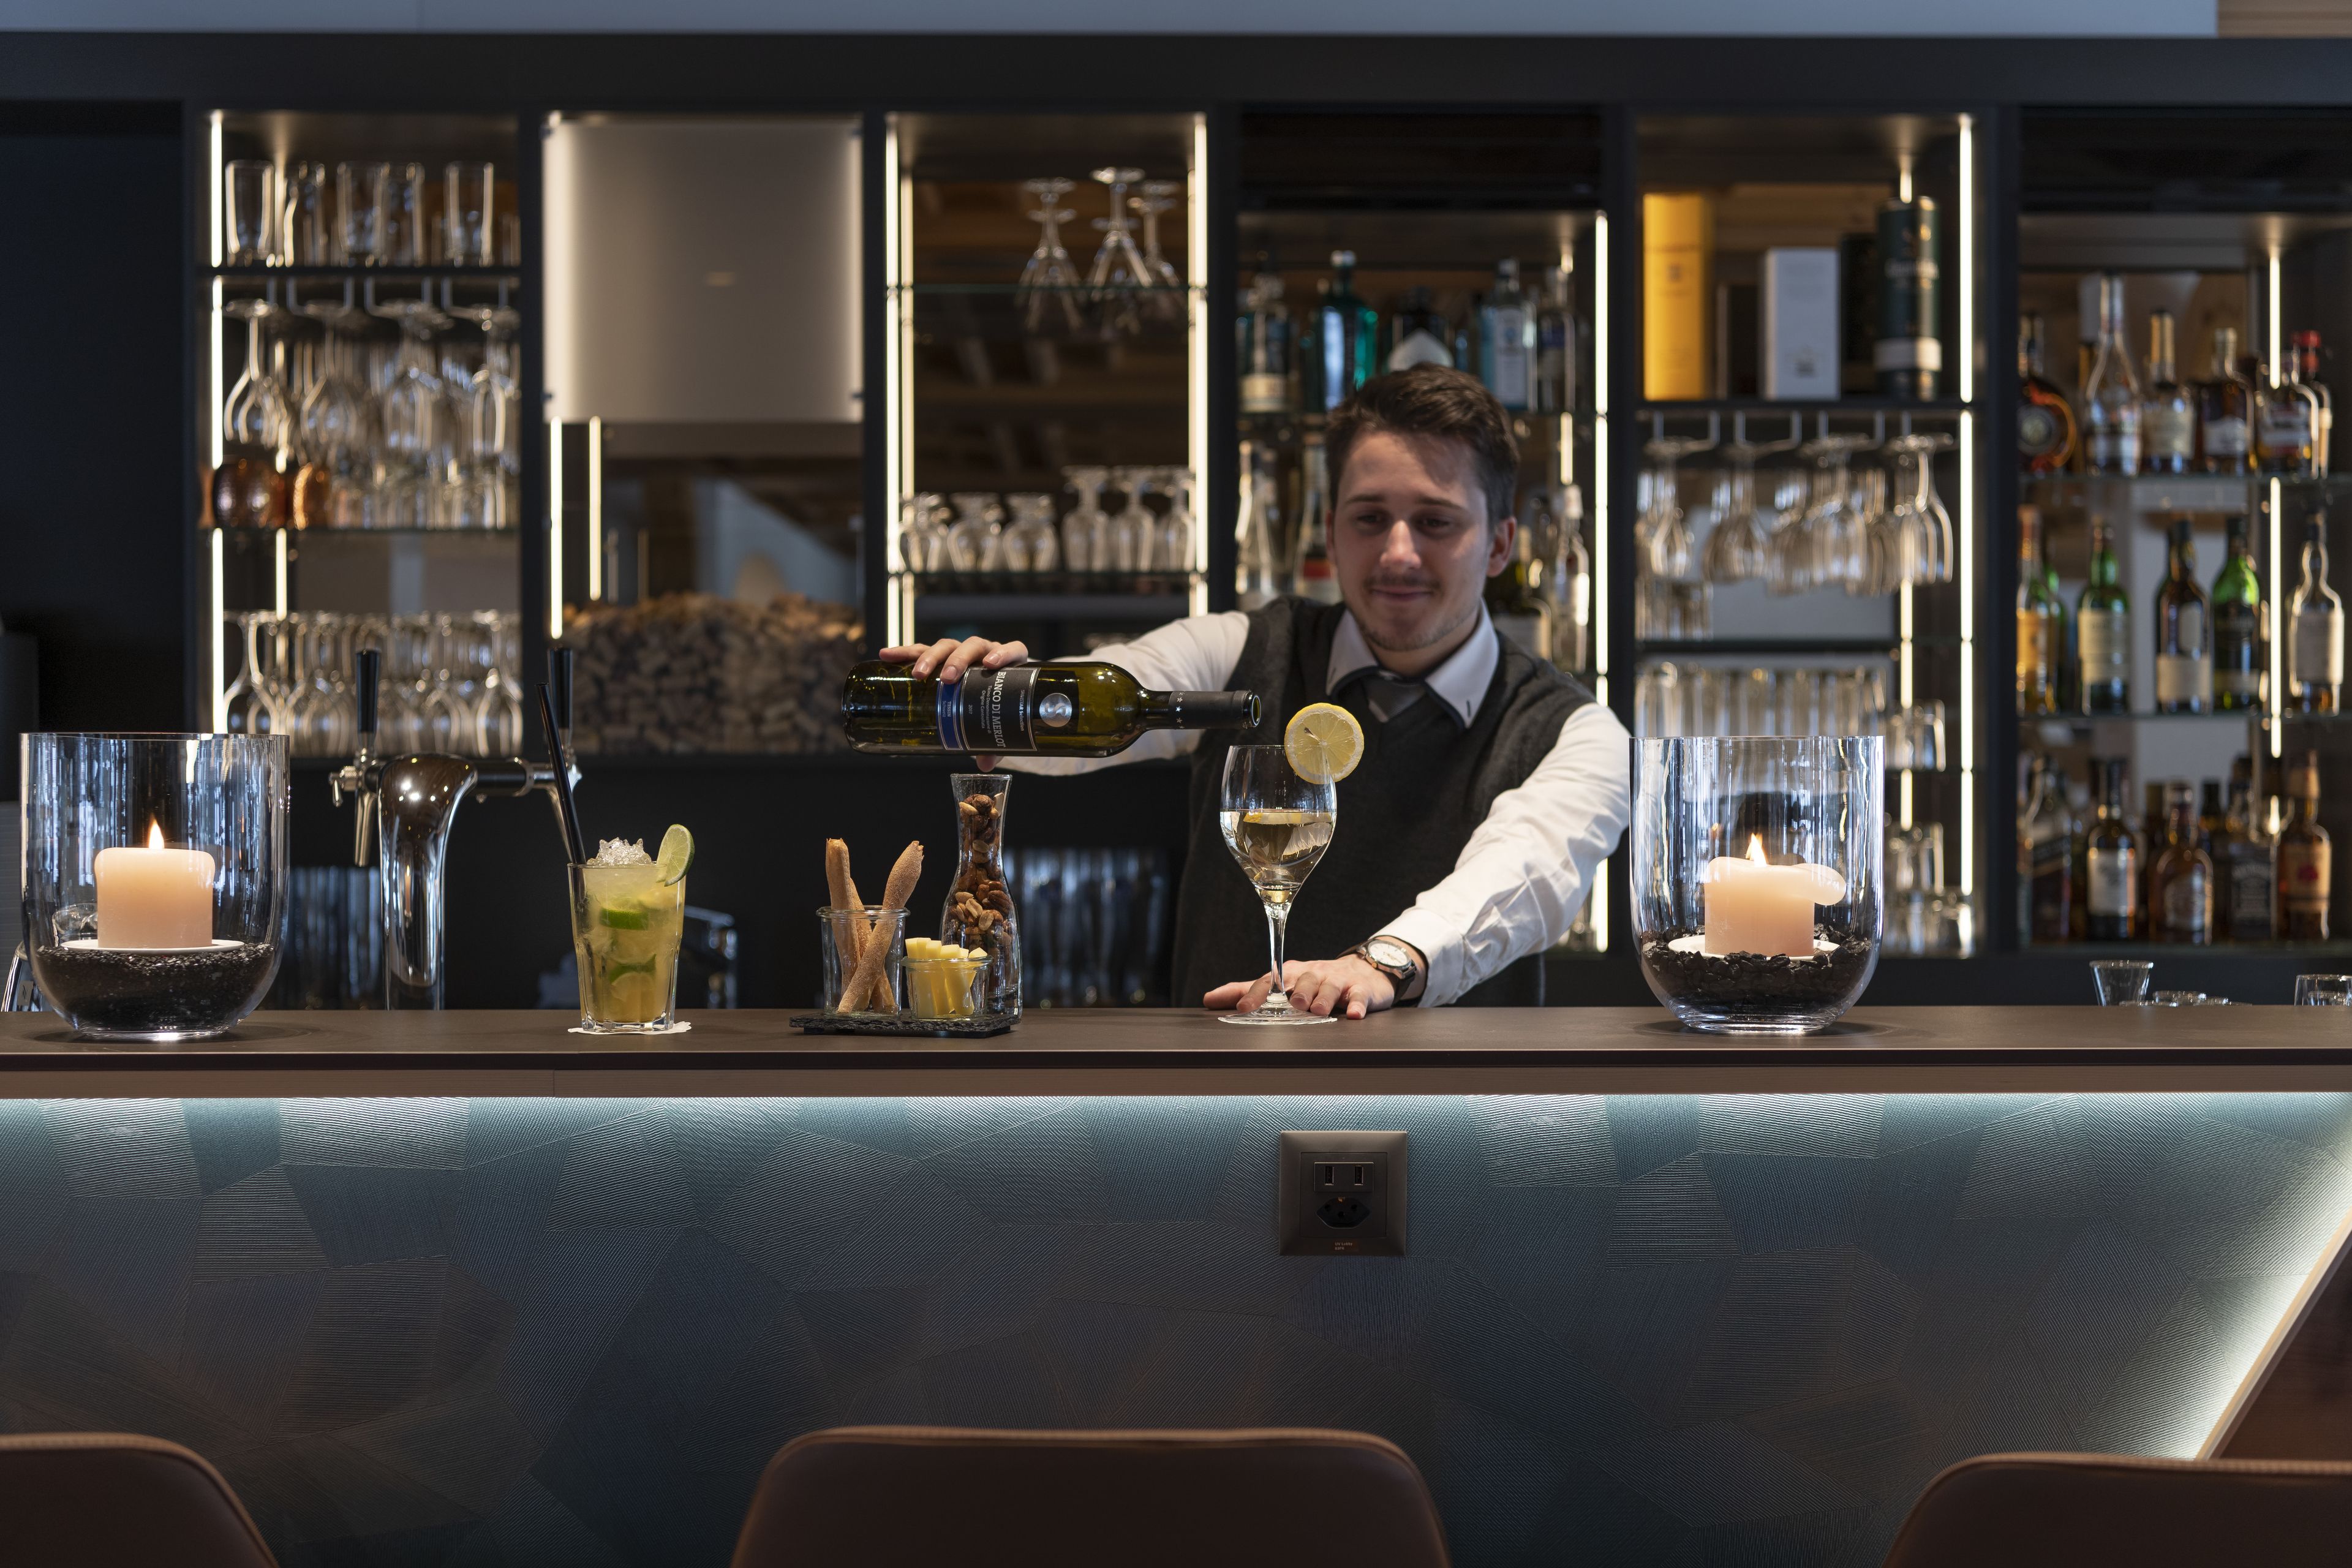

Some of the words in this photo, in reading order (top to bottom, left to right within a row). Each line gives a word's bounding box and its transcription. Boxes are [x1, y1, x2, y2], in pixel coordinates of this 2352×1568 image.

[992, 671, 1006, 702] BIANCO
[992, 704, 1000, 714] DI
[992, 715, 1006, 748] MERLOT
